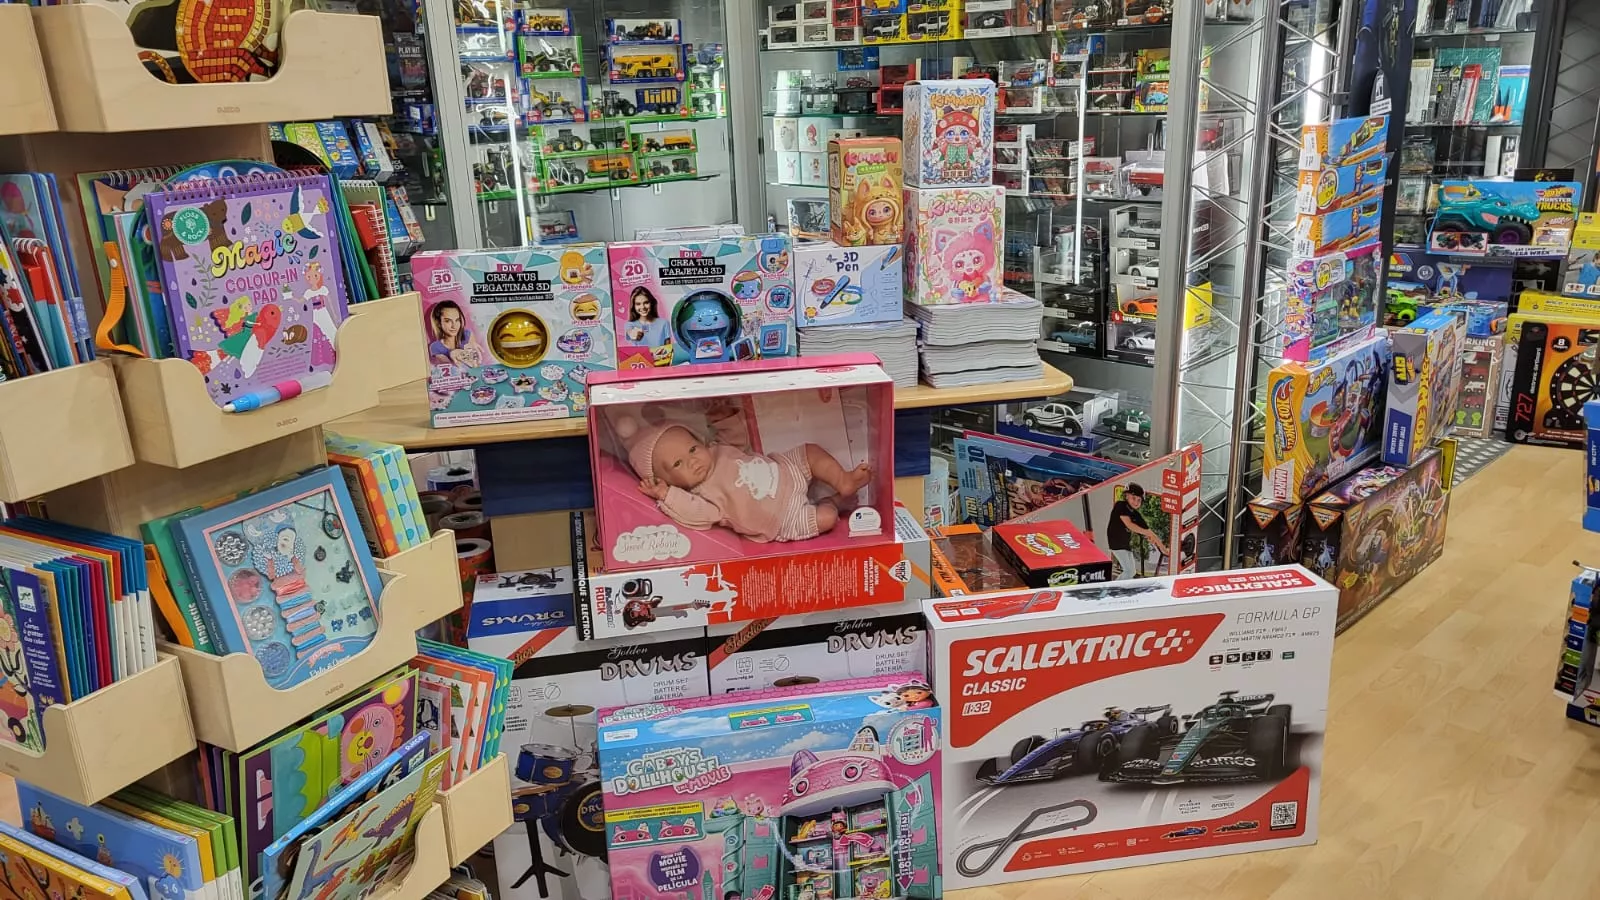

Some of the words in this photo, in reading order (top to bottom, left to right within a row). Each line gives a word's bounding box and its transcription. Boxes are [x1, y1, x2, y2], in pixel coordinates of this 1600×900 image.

[930, 93, 986, 109] KIMMON
[928, 197, 996, 219] KIMMON
[1536, 202, 1571, 211] TRUCKS
[179, 210, 199, 222] FLOSS
[211, 229, 297, 278] Magic
[843, 251, 859, 263] 3D
[502, 264, 518, 272] DIY
[624, 264, 643, 275] 20
[671, 259, 694, 267] CREA
[697, 258, 713, 266] TUS
[836, 261, 859, 273] Pen
[434, 274, 452, 285] 30
[486, 273, 513, 282] CREA
[516, 272, 537, 281] TUS
[663, 267, 710, 276] TARJETAS
[711, 267, 723, 275] 3D
[225, 268, 298, 295] COLOUR-IN
[475, 283, 536, 294] PEGATINAS
[536, 282, 550, 291] 3D
[253, 288, 278, 305] PAD
[1558, 338, 1566, 346] 8
[441, 368, 450, 377] 2
[1395, 356, 1408, 382] CITY
[1276, 397, 1292, 419] HOT
[1515, 393, 1535, 422] 727
[967, 446, 985, 464] 10
[1274, 469, 1287, 499] MARVEL
[1203, 577, 1303, 594] SCALEXTRIC
[595, 586, 606, 615] ROCK
[482, 609, 565, 626] DRUMS
[1237, 607, 1299, 624] FORMULA
[1302, 606, 1321, 619] GP
[187, 602, 209, 645] Magnetic
[833, 619, 873, 633] Golden
[827, 626, 918, 654] DRUMS
[607, 644, 648, 659] Golden
[876, 653, 895, 661] DRUM
[962, 631, 1155, 677] SCALEXTRIC
[600, 652, 697, 681] DRUMS
[653, 680, 675, 688] DRUM
[962, 677, 1027, 697] CLASSIC
[404, 733, 425, 751] DJECO
[628, 750, 702, 776] GABBY'S
[614, 758, 720, 795] DOLLHOUSE
[688, 767, 730, 790] MOVIE
[581, 803, 603, 815] DRU
[659, 856, 687, 867] MOVIE
[665, 868, 685, 878] FILM
[658, 877, 698, 892] PELÍCULA
